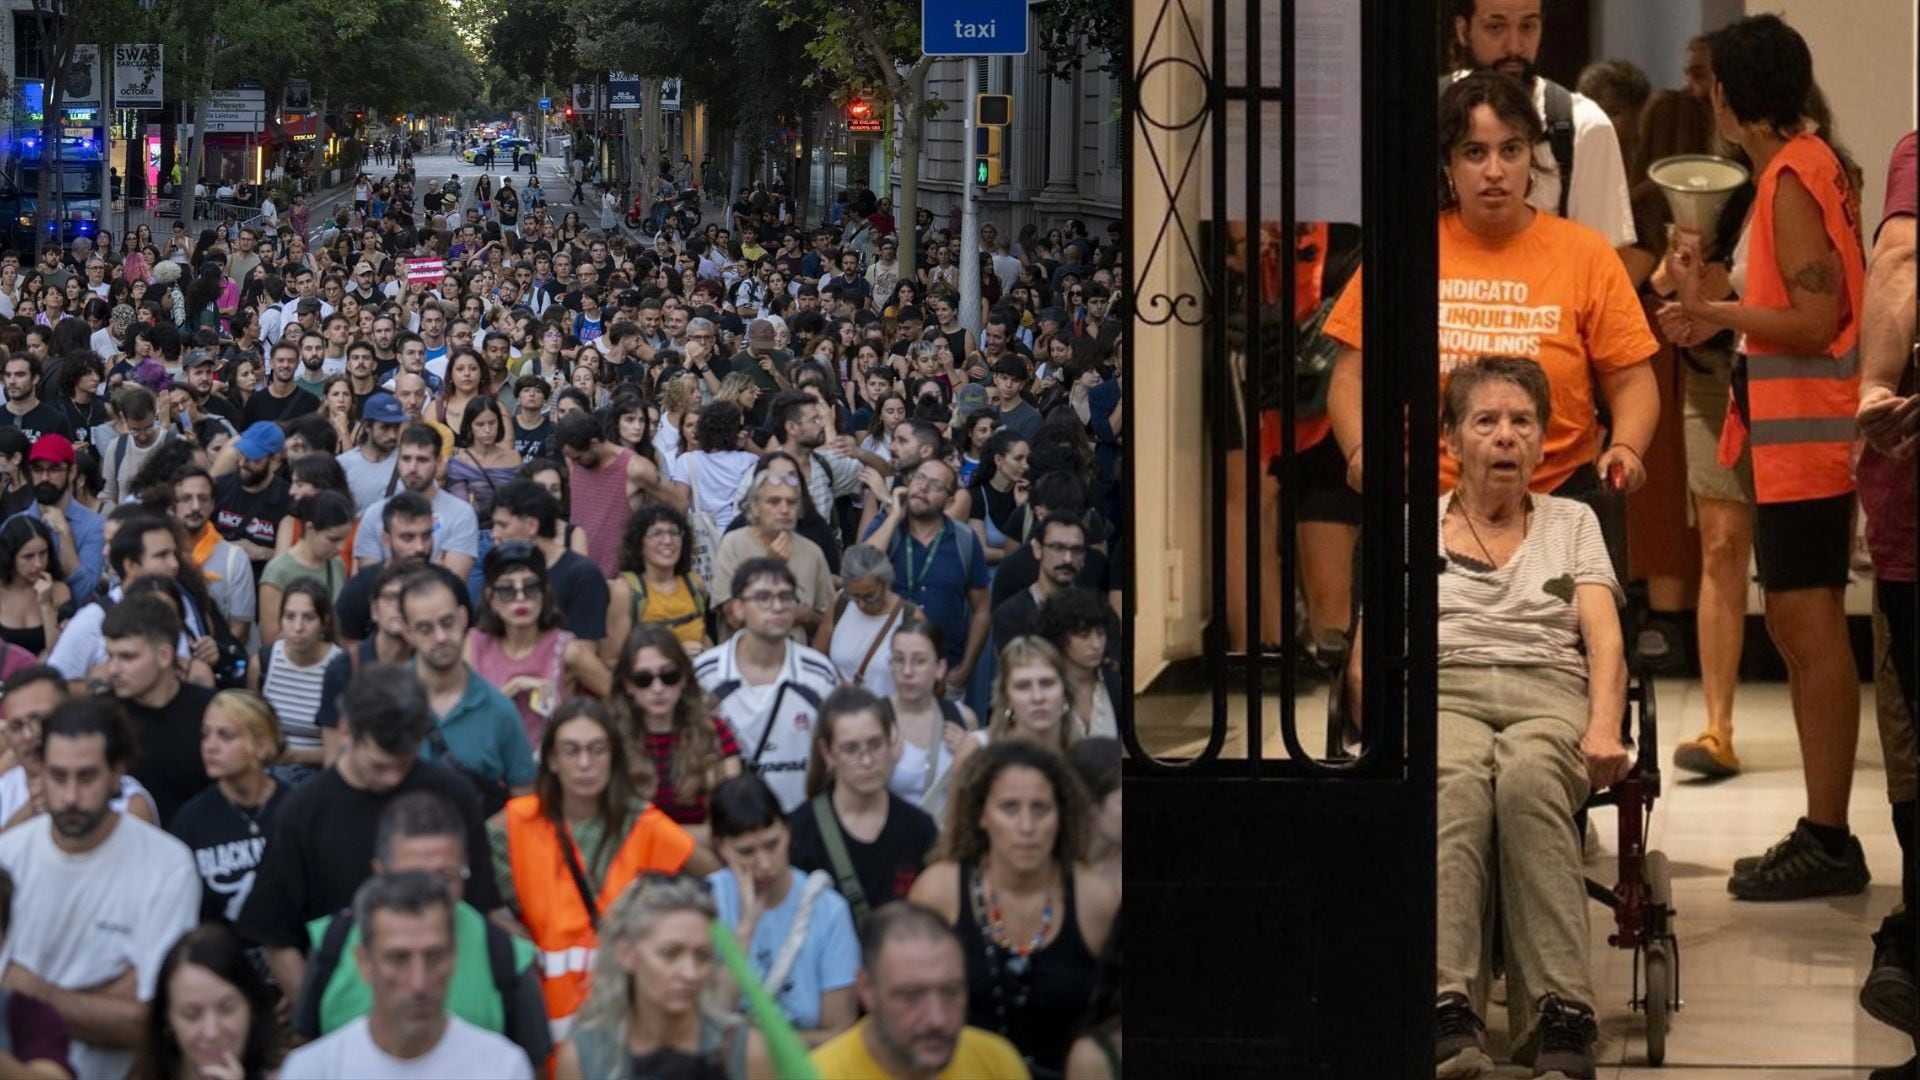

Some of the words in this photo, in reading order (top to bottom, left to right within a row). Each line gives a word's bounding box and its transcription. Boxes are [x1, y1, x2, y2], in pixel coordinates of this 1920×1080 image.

[953, 19, 996, 38] taxi
[116, 48, 160, 61] SWAB
[120, 88, 154, 96] OCTOBER
[1446, 307, 1557, 329] INQUILINAS
